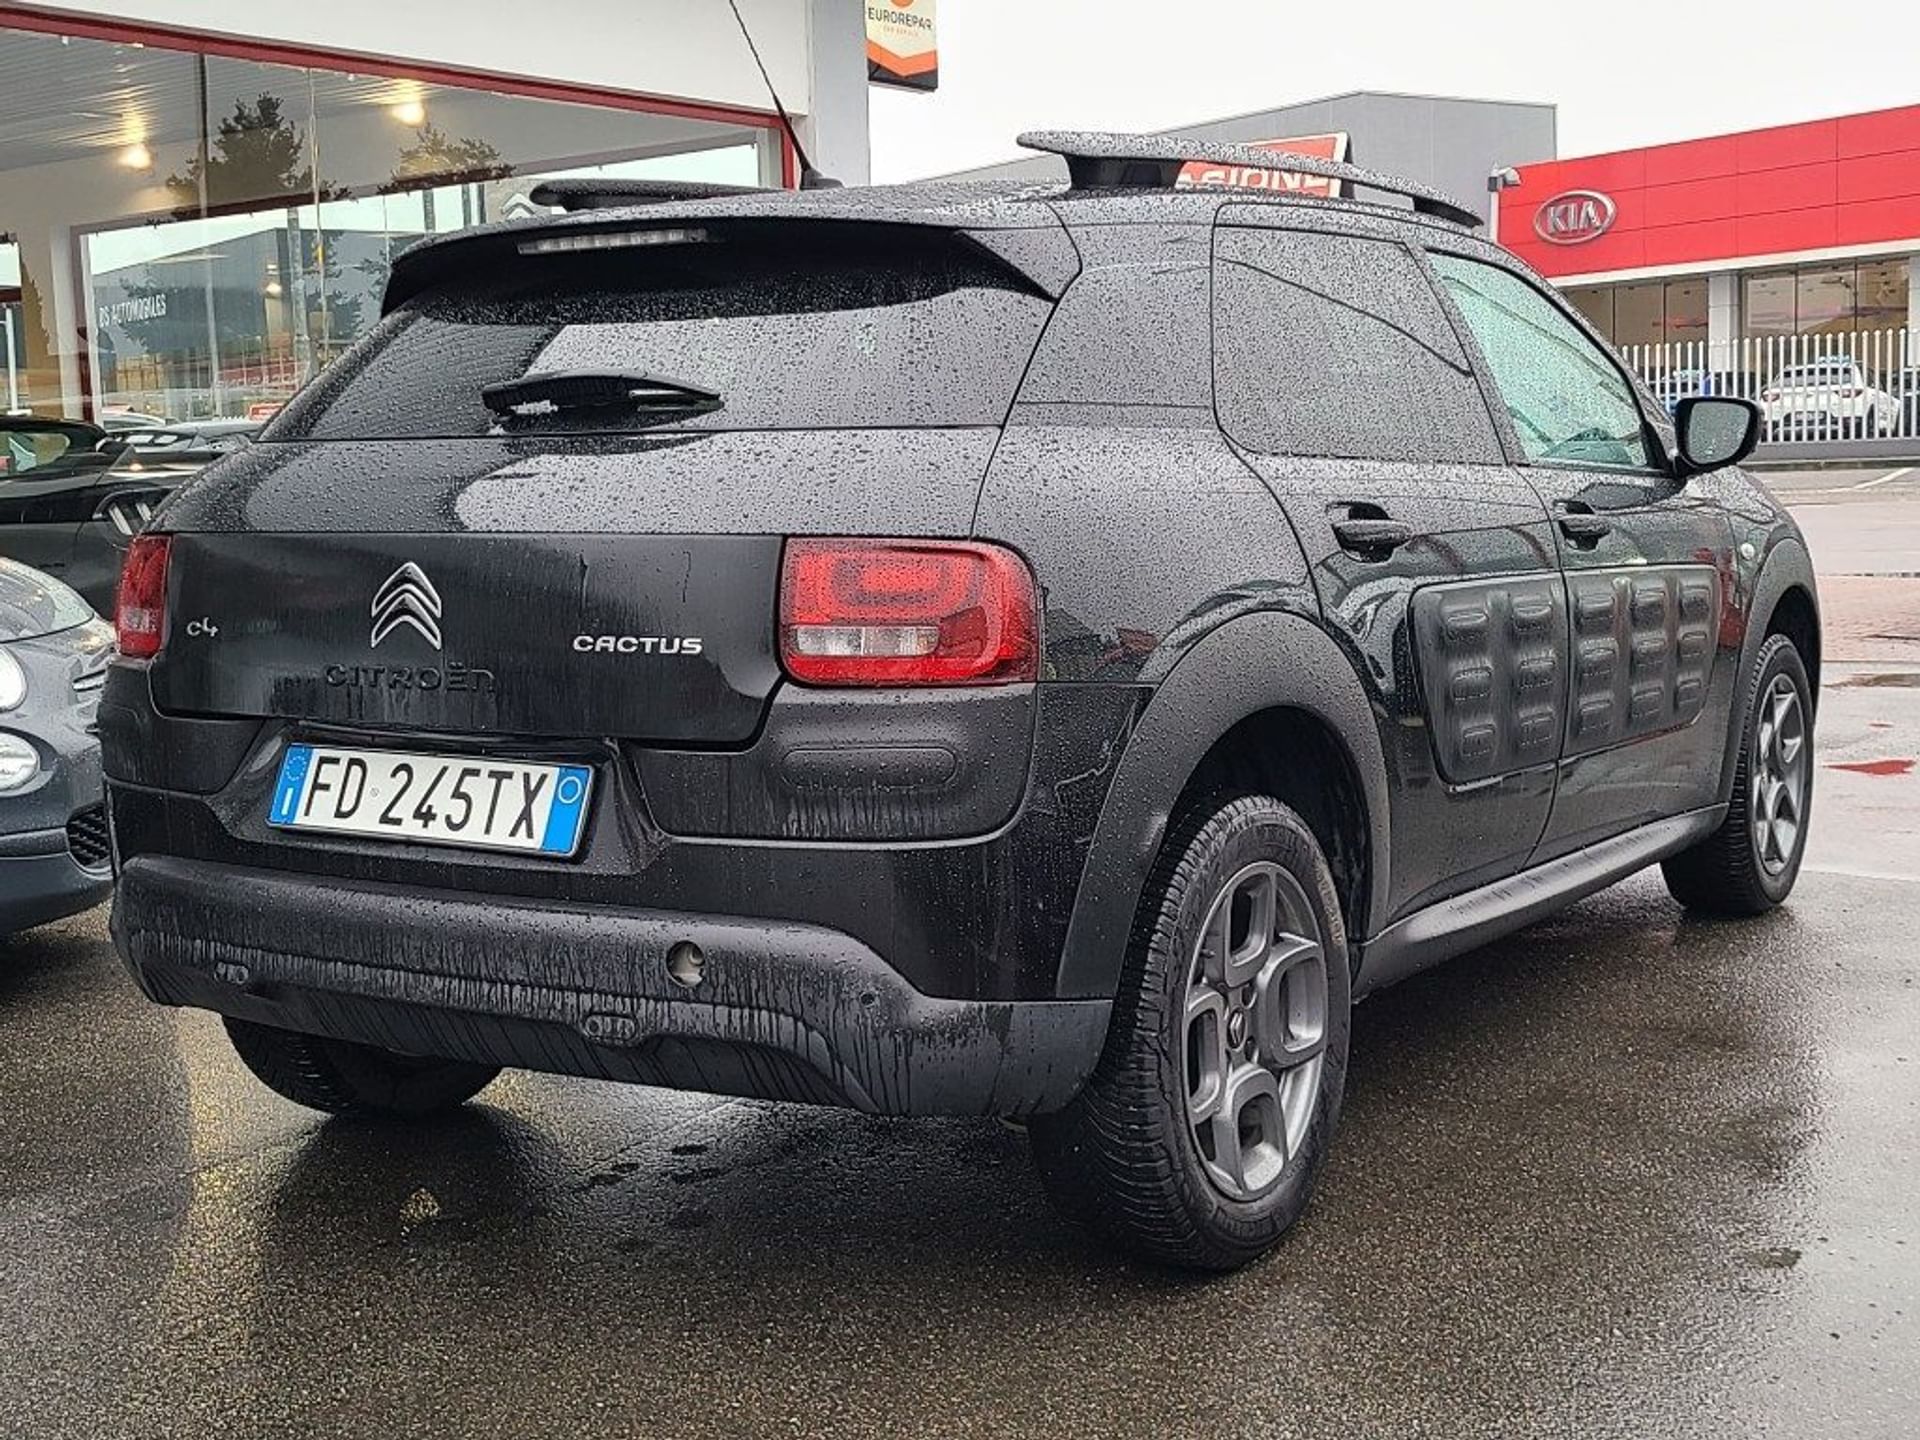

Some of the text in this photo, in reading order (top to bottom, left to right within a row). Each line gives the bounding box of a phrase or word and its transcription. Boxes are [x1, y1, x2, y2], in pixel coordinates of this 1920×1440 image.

[868, 7, 932, 31] EUROREPAR
[1547, 200, 1602, 234] KIA
[573, 635, 703, 654] CACTUS
[304, 756, 549, 839] FD 245TX
